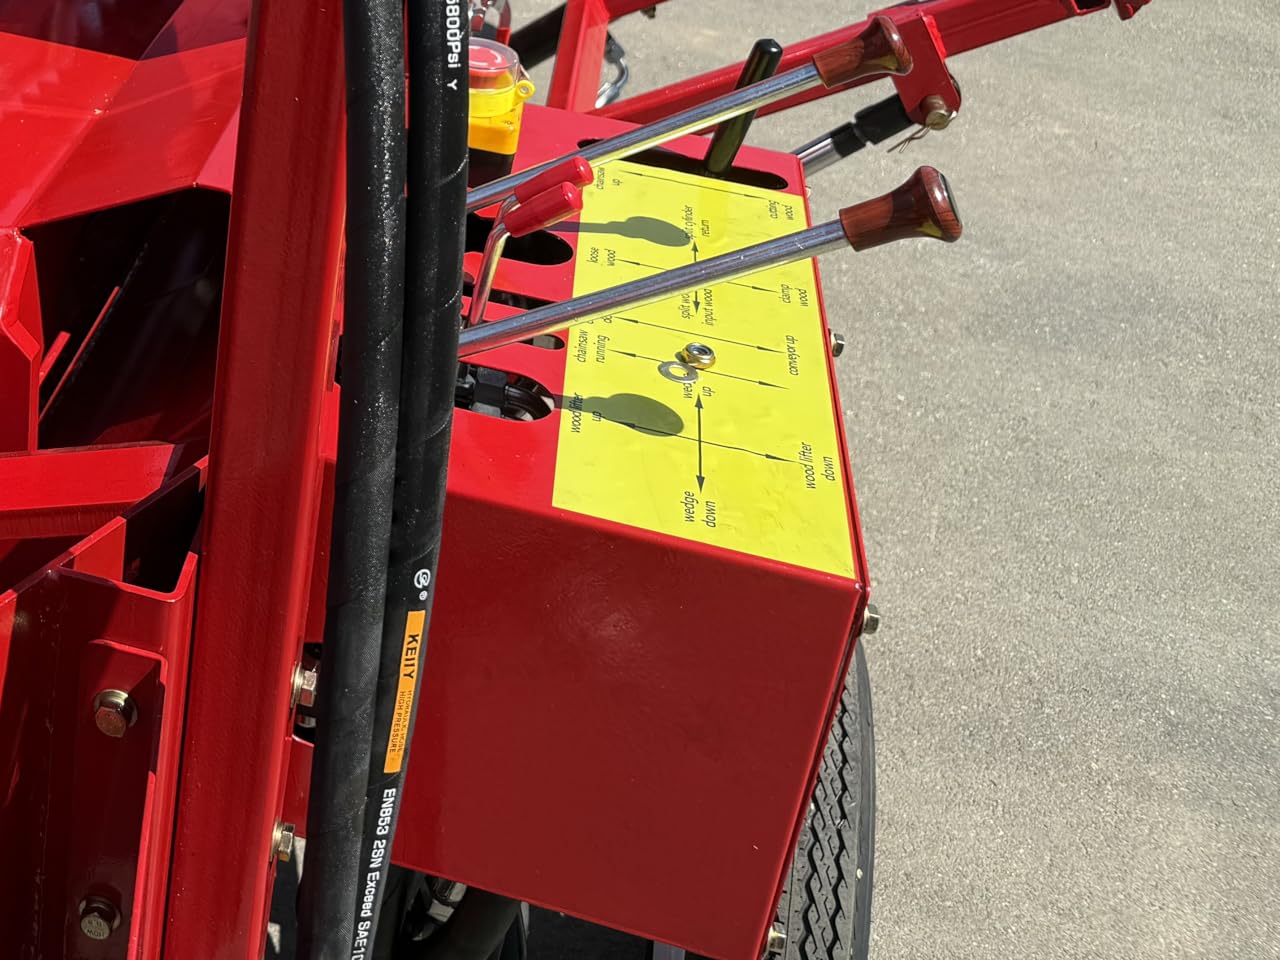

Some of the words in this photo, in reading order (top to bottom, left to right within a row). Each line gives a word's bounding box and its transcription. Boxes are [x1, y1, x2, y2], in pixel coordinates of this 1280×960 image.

[573, 329, 588, 363] chainsaw
[593, 335, 610, 364] running
[799, 463, 816, 489] wood
[821, 456, 836, 481] down
[680, 490, 699, 522] wedge
[701, 501, 717, 528] down
[376, 788, 397, 836] EN853
[370, 839, 387, 868] 2SN
[360, 871, 380, 918] Exceed
